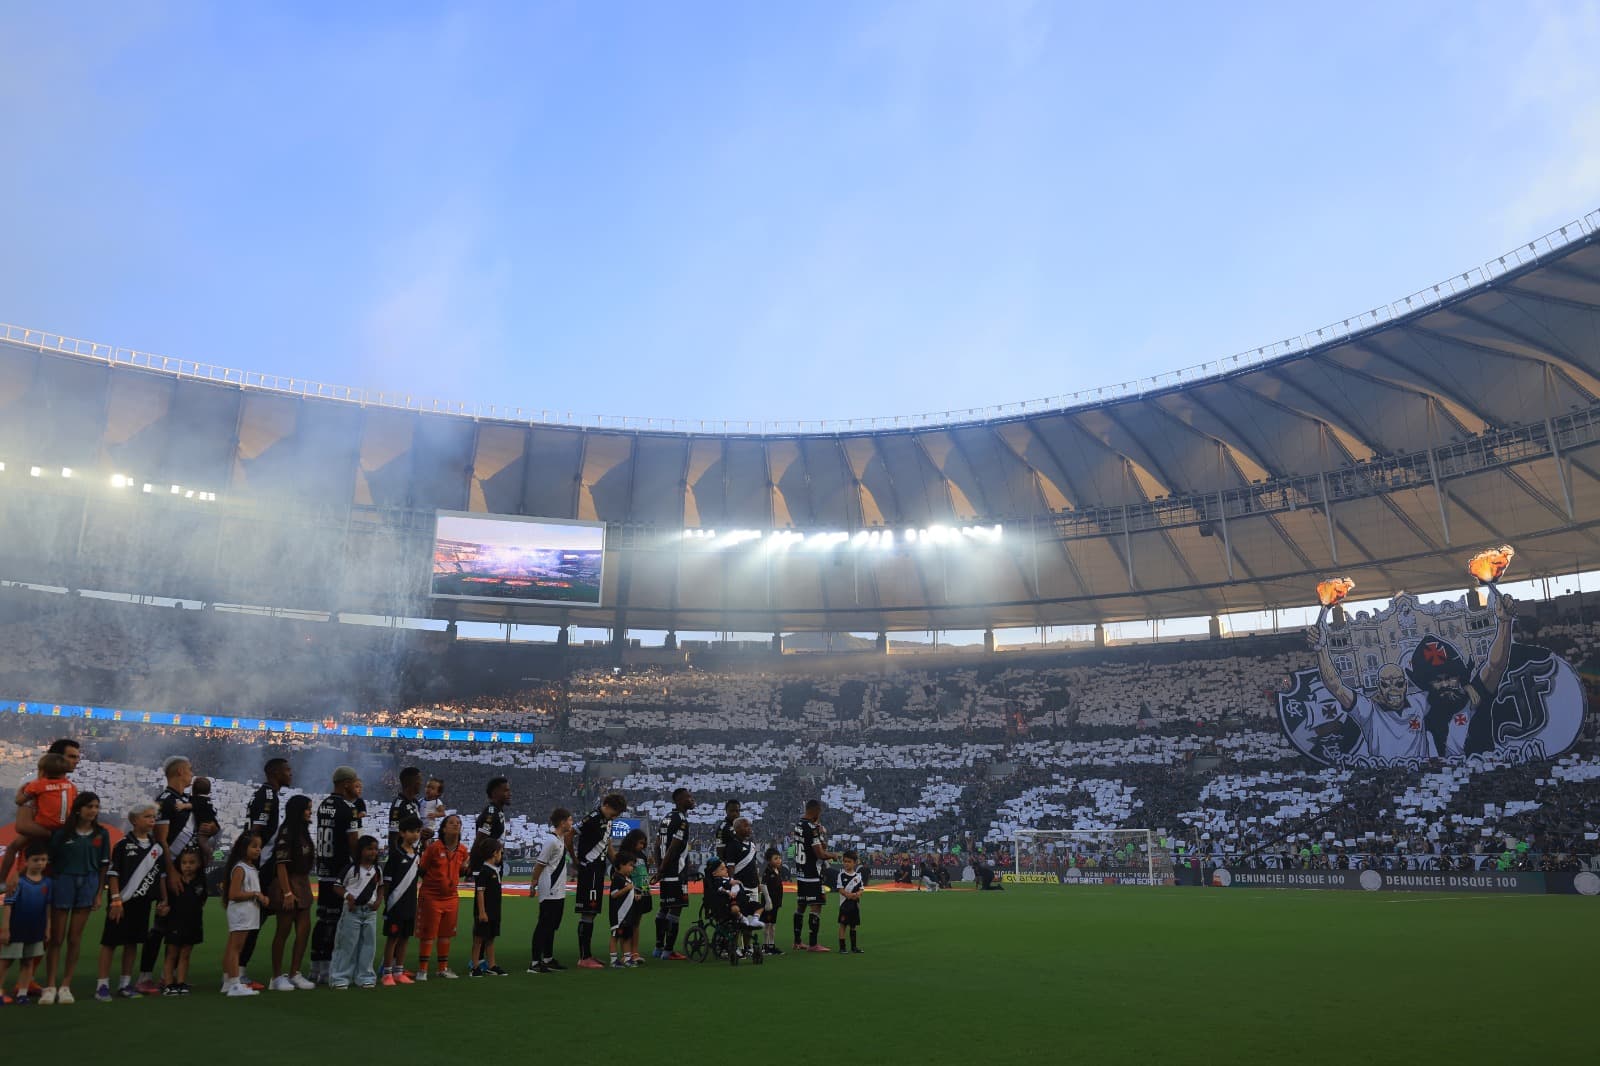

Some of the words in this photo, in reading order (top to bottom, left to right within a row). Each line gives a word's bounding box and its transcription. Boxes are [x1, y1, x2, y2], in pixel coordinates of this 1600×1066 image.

[318, 827, 334, 858] 88
[1235, 873, 1285, 883] DENUNCIE!
[1288, 874, 1325, 884] DISQUE
[1327, 875, 1345, 884] 100
[1386, 875, 1445, 885] DENUNCIE!
[1449, 876, 1493, 887] DISQUE
[1497, 877, 1517, 887] 100
